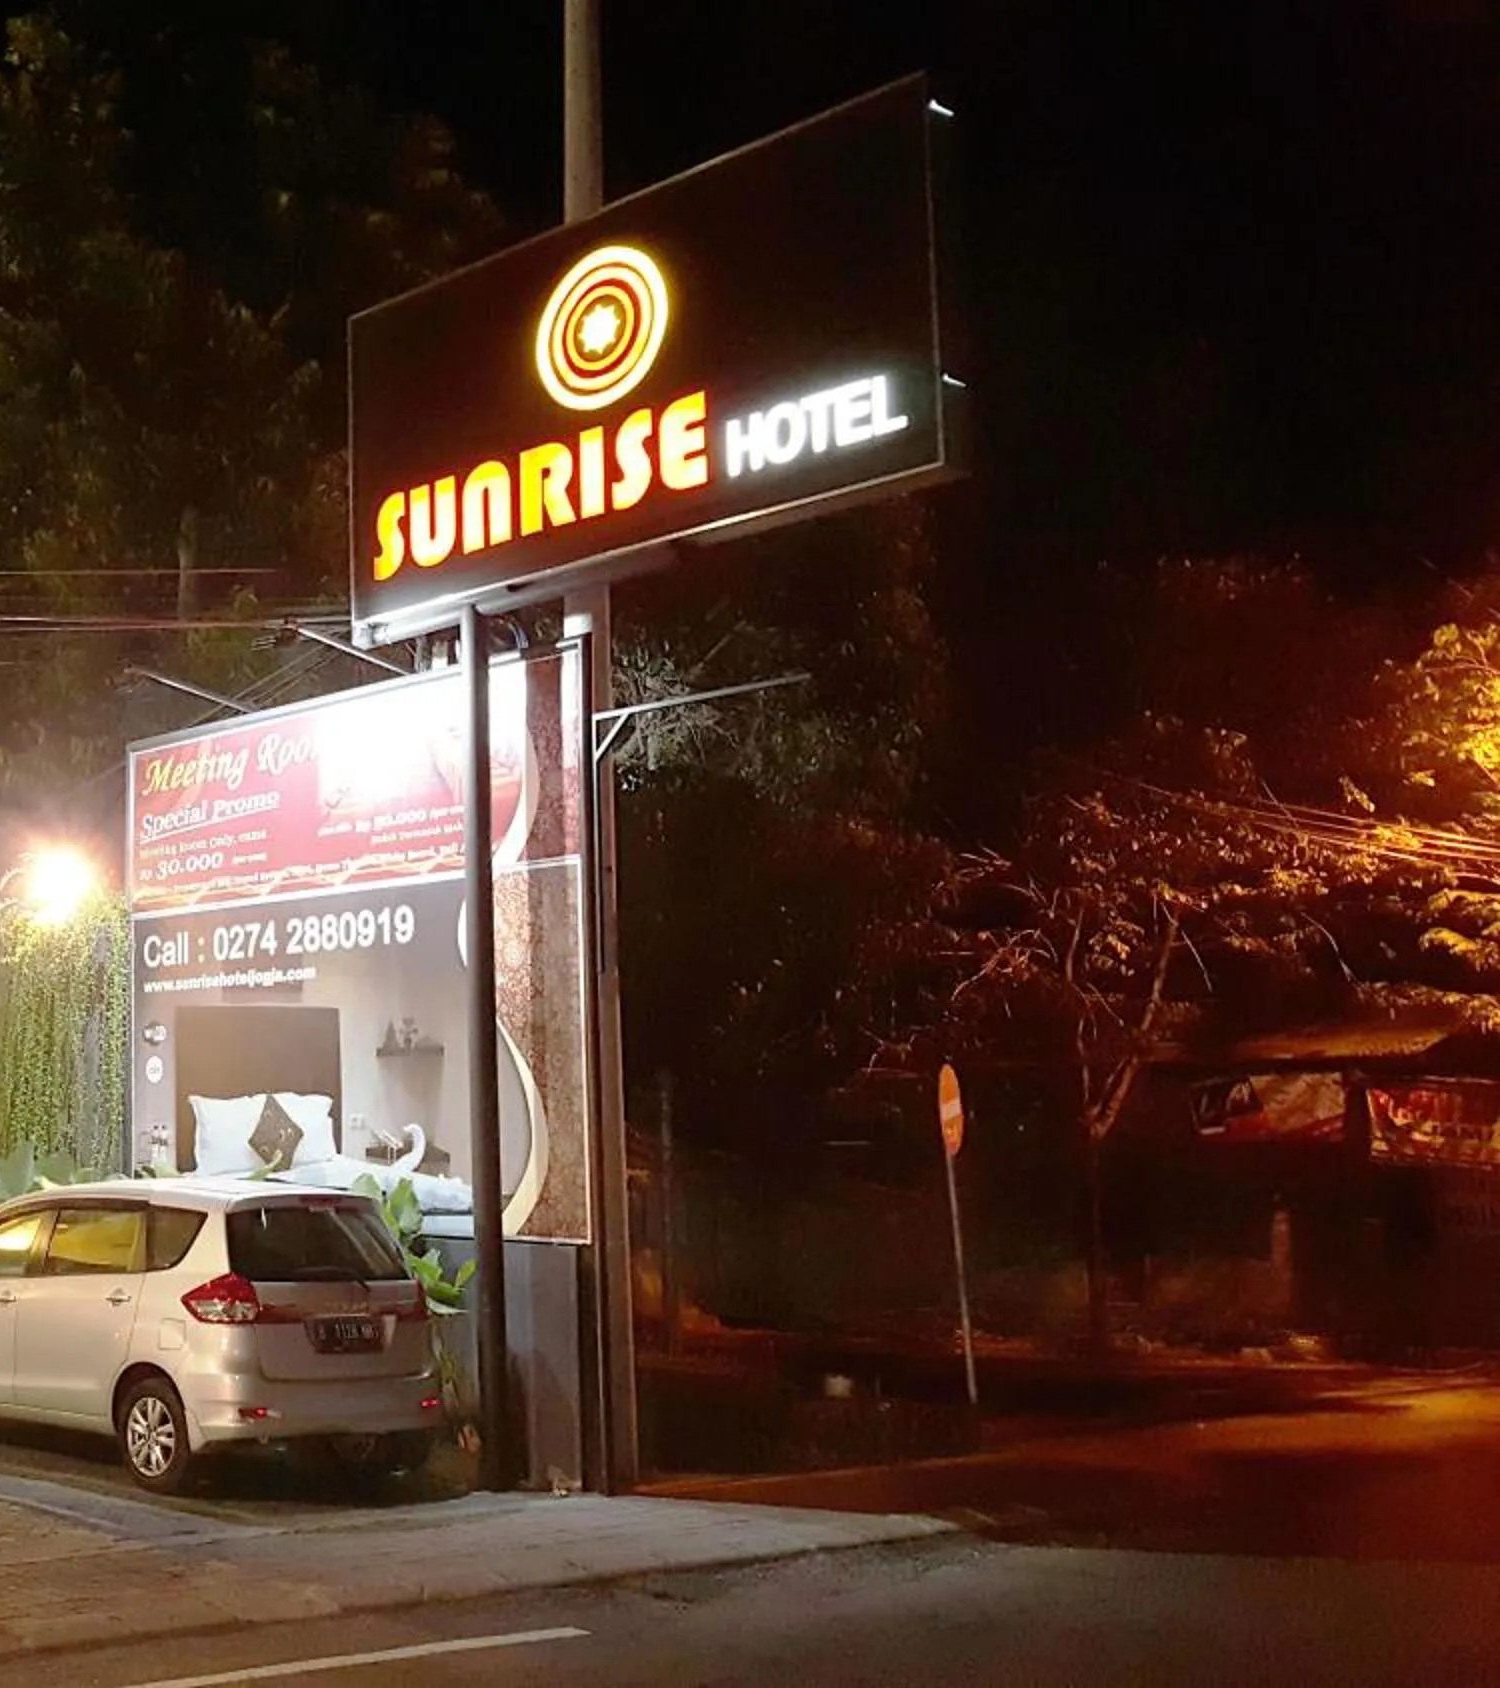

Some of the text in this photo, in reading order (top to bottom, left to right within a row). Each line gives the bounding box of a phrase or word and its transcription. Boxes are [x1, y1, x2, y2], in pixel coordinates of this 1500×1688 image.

[373, 375, 908, 581] SUNRISE HOTEL
[141, 734, 321, 796] Meeting Roo
[141, 803, 208, 838] Special
[213, 791, 280, 820] Promo
[155, 852, 225, 881] 30.000
[143, 931, 189, 968] Call
[212, 920, 277, 961] 0274
[286, 904, 415, 956] 2880919
